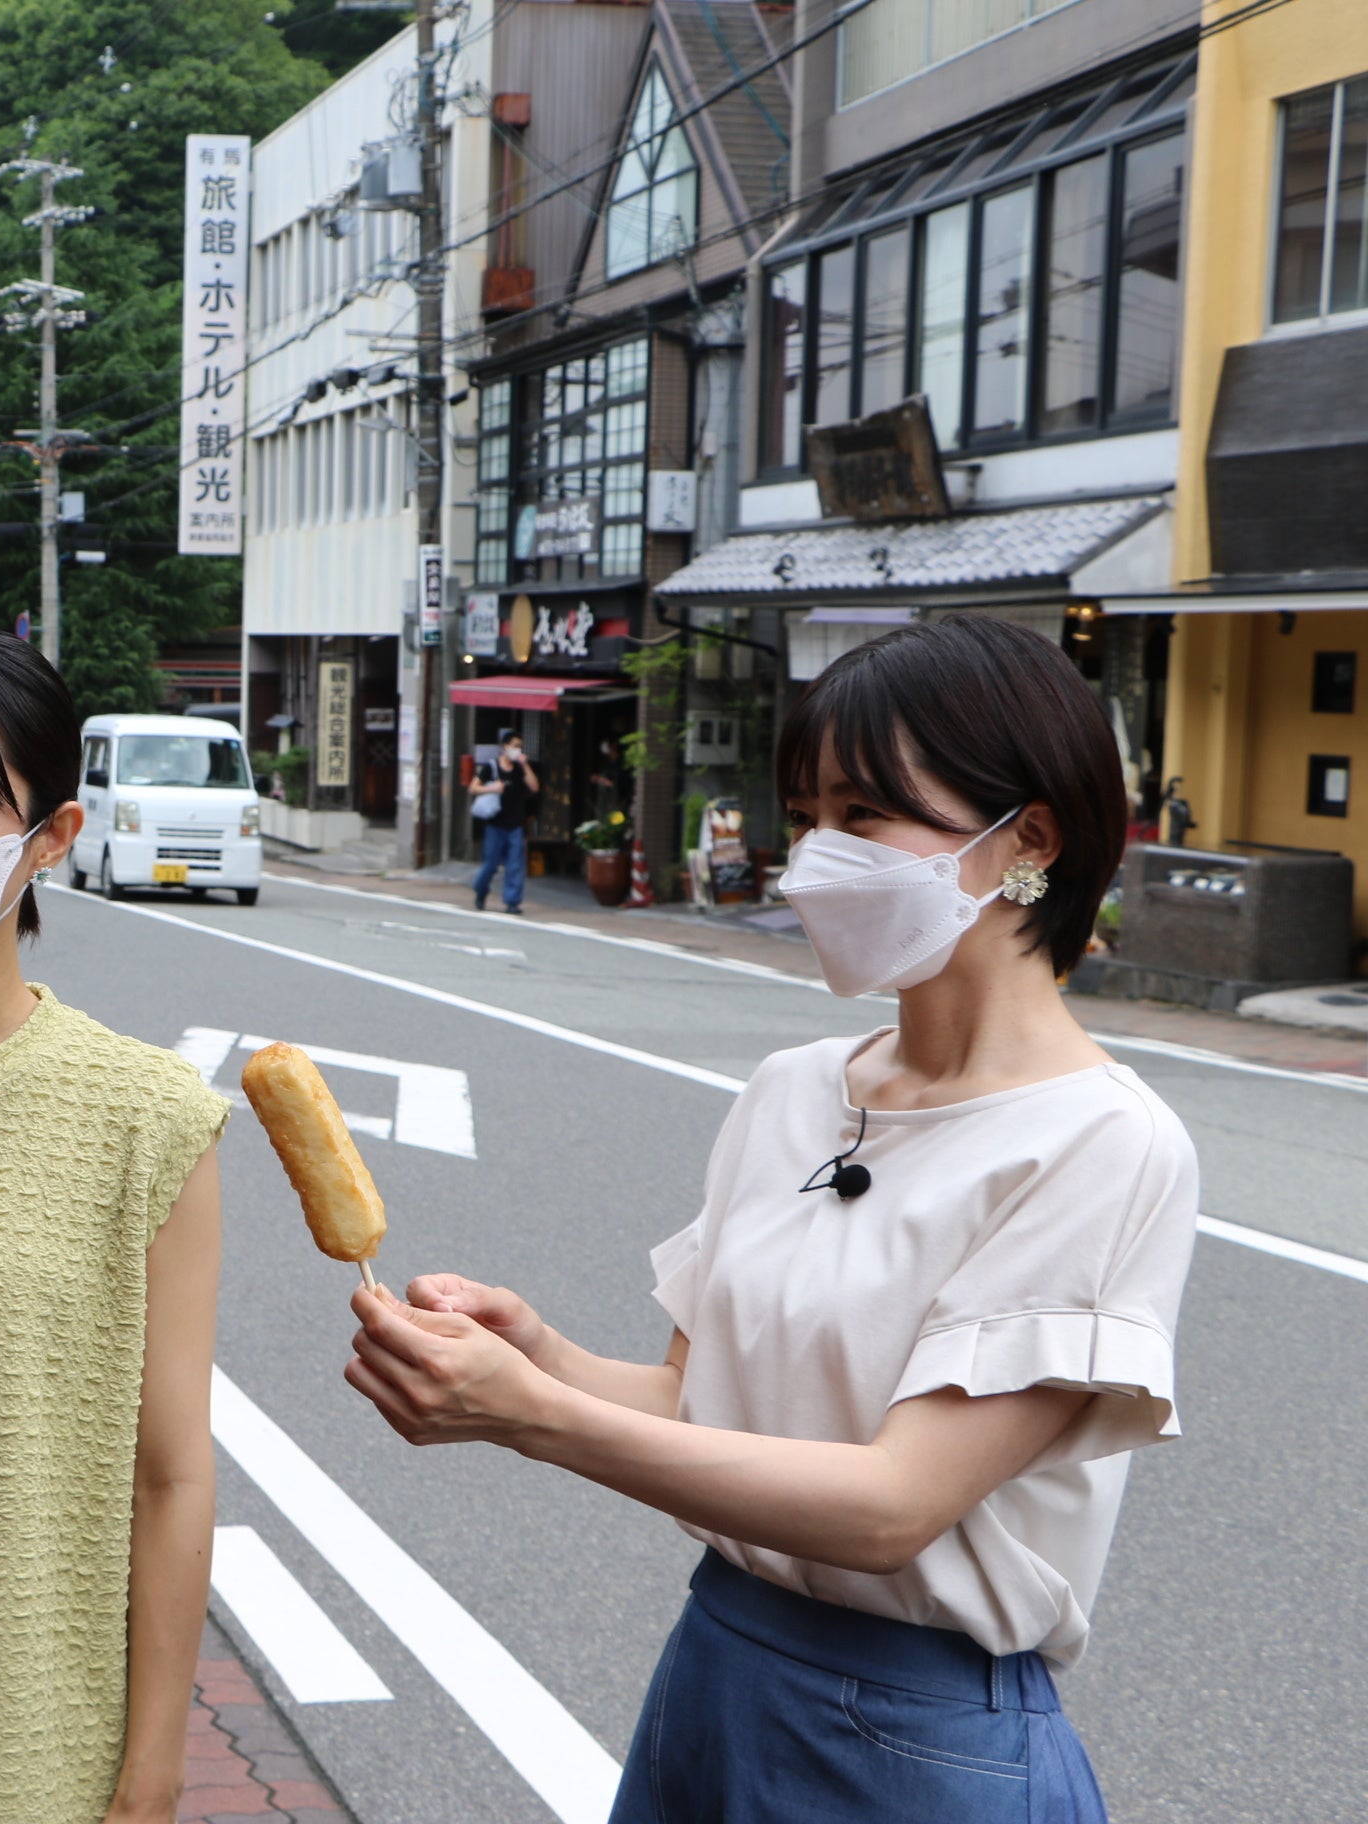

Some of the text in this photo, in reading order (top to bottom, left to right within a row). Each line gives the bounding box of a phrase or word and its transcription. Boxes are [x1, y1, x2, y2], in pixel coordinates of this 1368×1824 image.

[195, 174, 236, 502] 旅館・ホテル・観光
